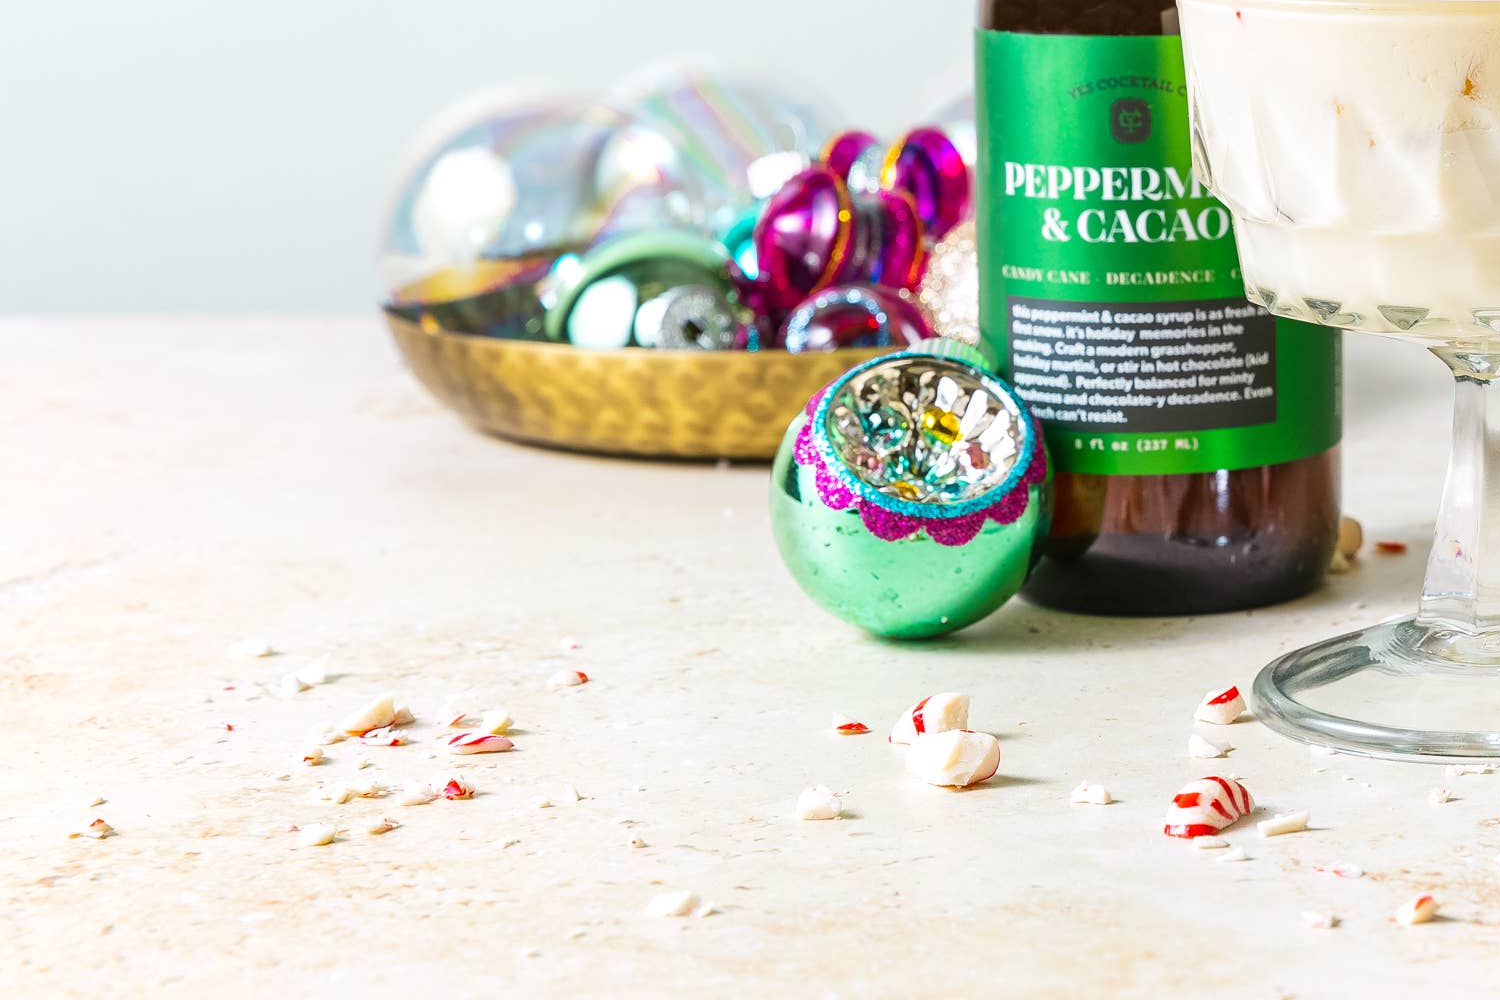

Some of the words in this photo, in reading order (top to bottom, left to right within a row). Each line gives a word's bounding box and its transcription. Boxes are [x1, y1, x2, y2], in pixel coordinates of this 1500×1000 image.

[1068, 81, 1094, 100] YES
[1096, 76, 1174, 93] COCKTAIL
[1004, 162, 1214, 201] PEPPERM
[1041, 207, 1071, 243] &
[1077, 207, 1229, 243] CACAO
[1002, 264, 1043, 283] CANDY
[1047, 269, 1090, 286] CANE
[1106, 269, 1215, 286] DECADENCE
[1031, 308, 1100, 324] peppermint
[1101, 309, 1113, 324] &
[1114, 312, 1154, 324] cacao
[1155, 311, 1194, 326] syrup
[1195, 308, 1206, 321] is
[1208, 309, 1223, 321] as
[1224, 304, 1255, 319] fresh
[1085, 326, 1136, 343] holiday
[1139, 325, 1206, 340] memories
[1207, 324, 1221, 337] in
[1222, 323, 1244, 336] the
[1055, 341, 1085, 356] Craft
[1086, 345, 1096, 357] a
[1096, 343, 1149, 357] modern
[1150, 342, 1237, 360] grasshopper,
[1013, 352, 1051, 373] holiday
[1051, 359, 1099, 375] martini,
[1100, 362, 1116, 374] or
[1117, 360, 1139, 374] stir
[1140, 360, 1155, 373] in
[1155, 359, 1180, 373] hot
[1181, 357, 1244, 372] chocolate
[1245, 351, 1269, 369] (kid
[1075, 375, 1133, 392] Perfectly
[1134, 375, 1197, 390] balanced
[1198, 374, 1217, 388] for
[1218, 372, 1255, 386] minty
[1063, 391, 1088, 405] and
[1088, 392, 1166, 409] chocolate-y
[1167, 390, 1242, 406] decadence.
[1243, 386, 1273, 400] Even
[1055, 407, 1087, 423] can't
[1088, 409, 1128, 424] resist.
